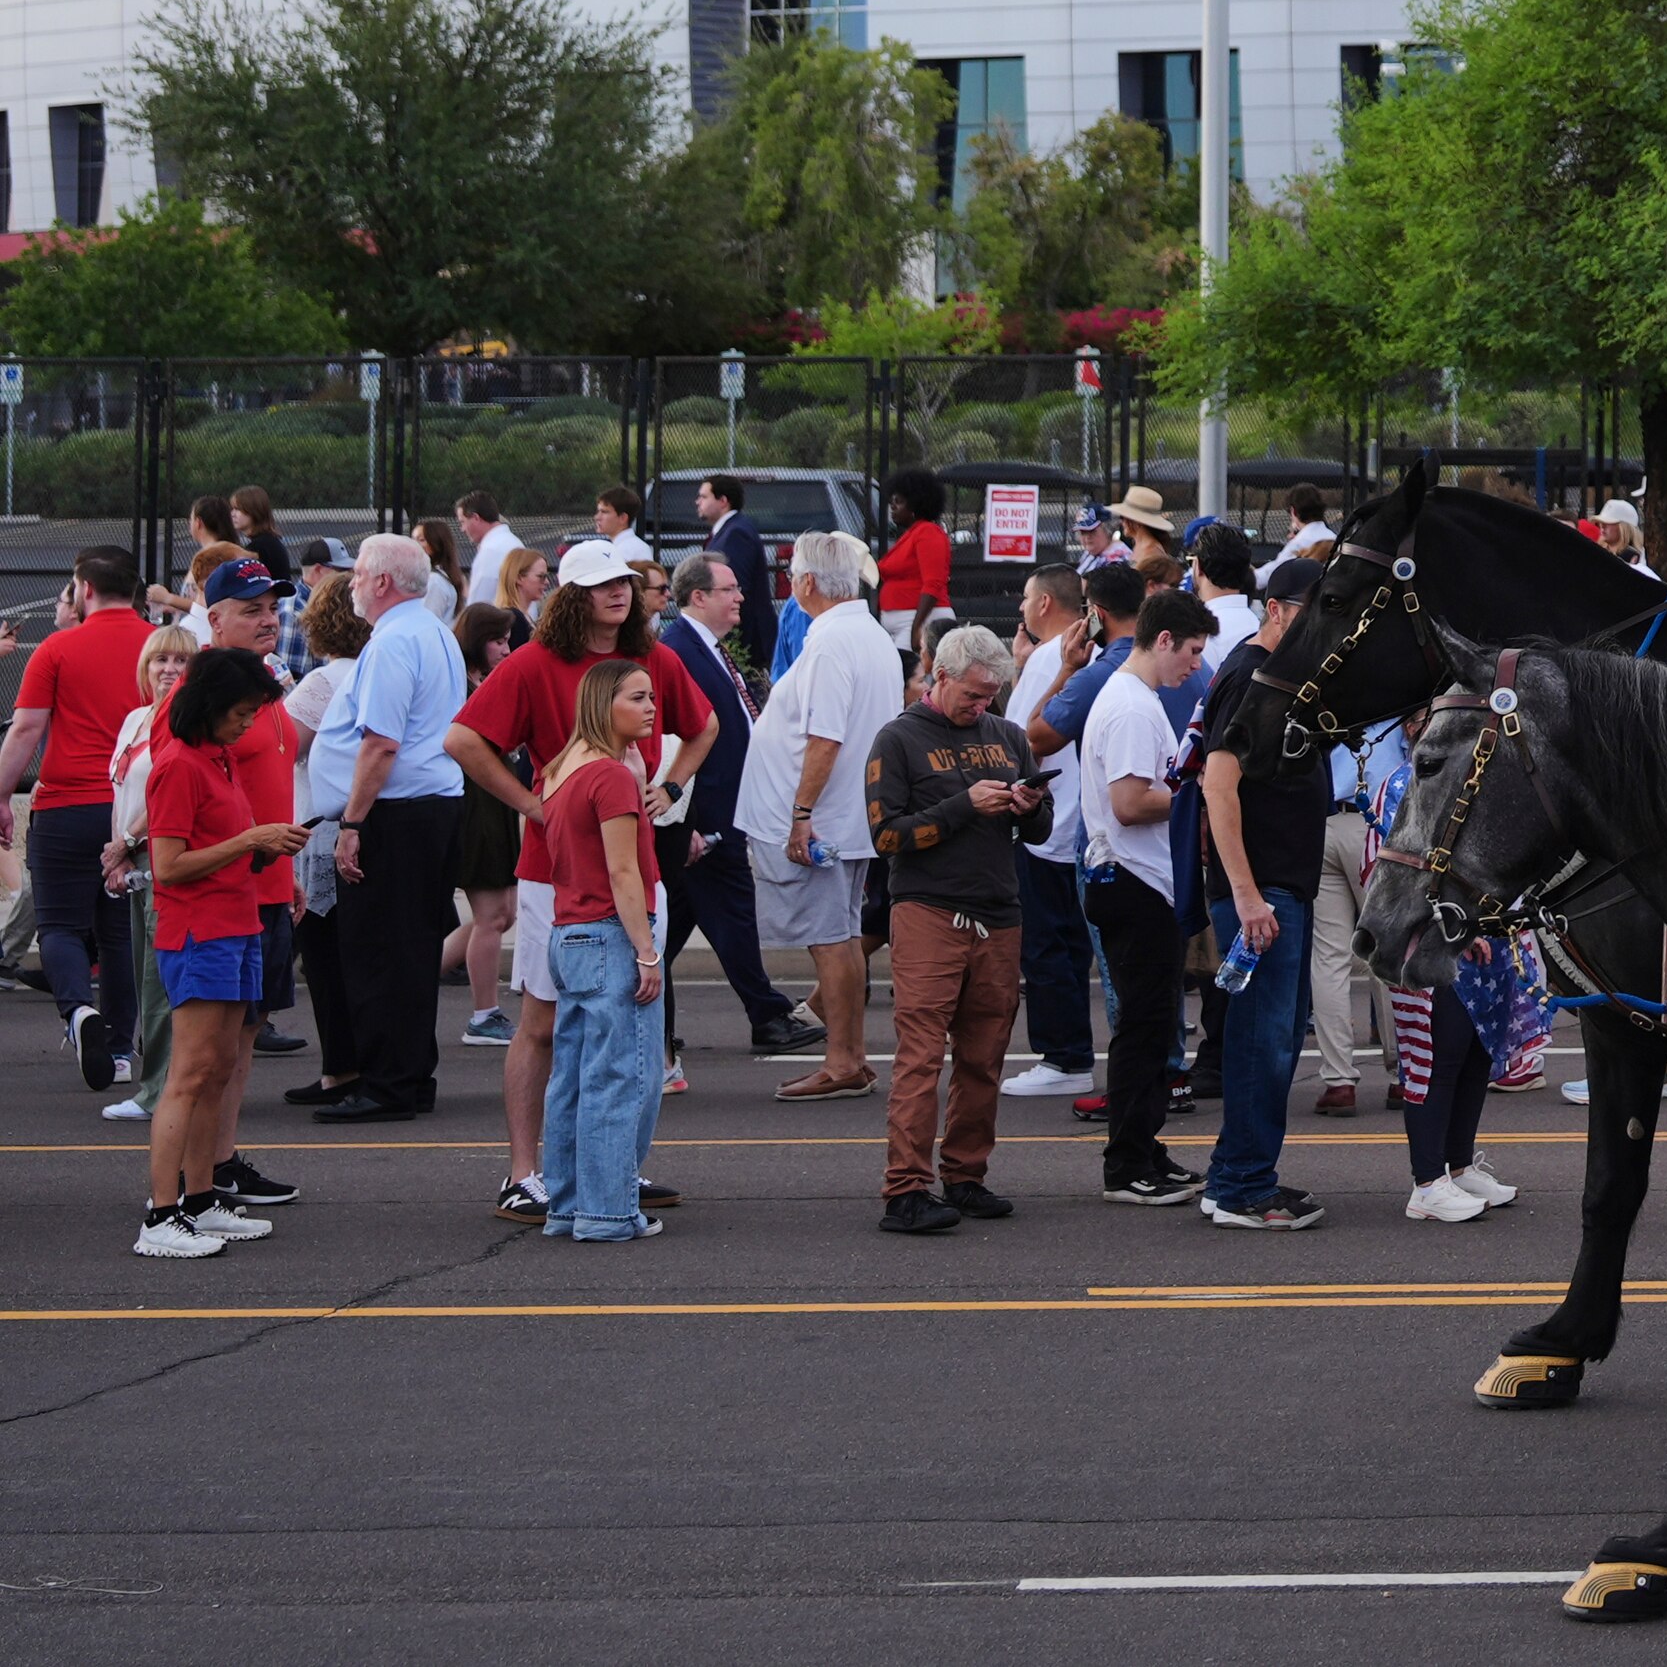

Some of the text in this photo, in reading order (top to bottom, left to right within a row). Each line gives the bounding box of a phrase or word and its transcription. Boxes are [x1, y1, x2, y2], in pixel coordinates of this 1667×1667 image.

[995, 508, 1030, 517] DO NOT
[996, 520, 1028, 529] ENTER
